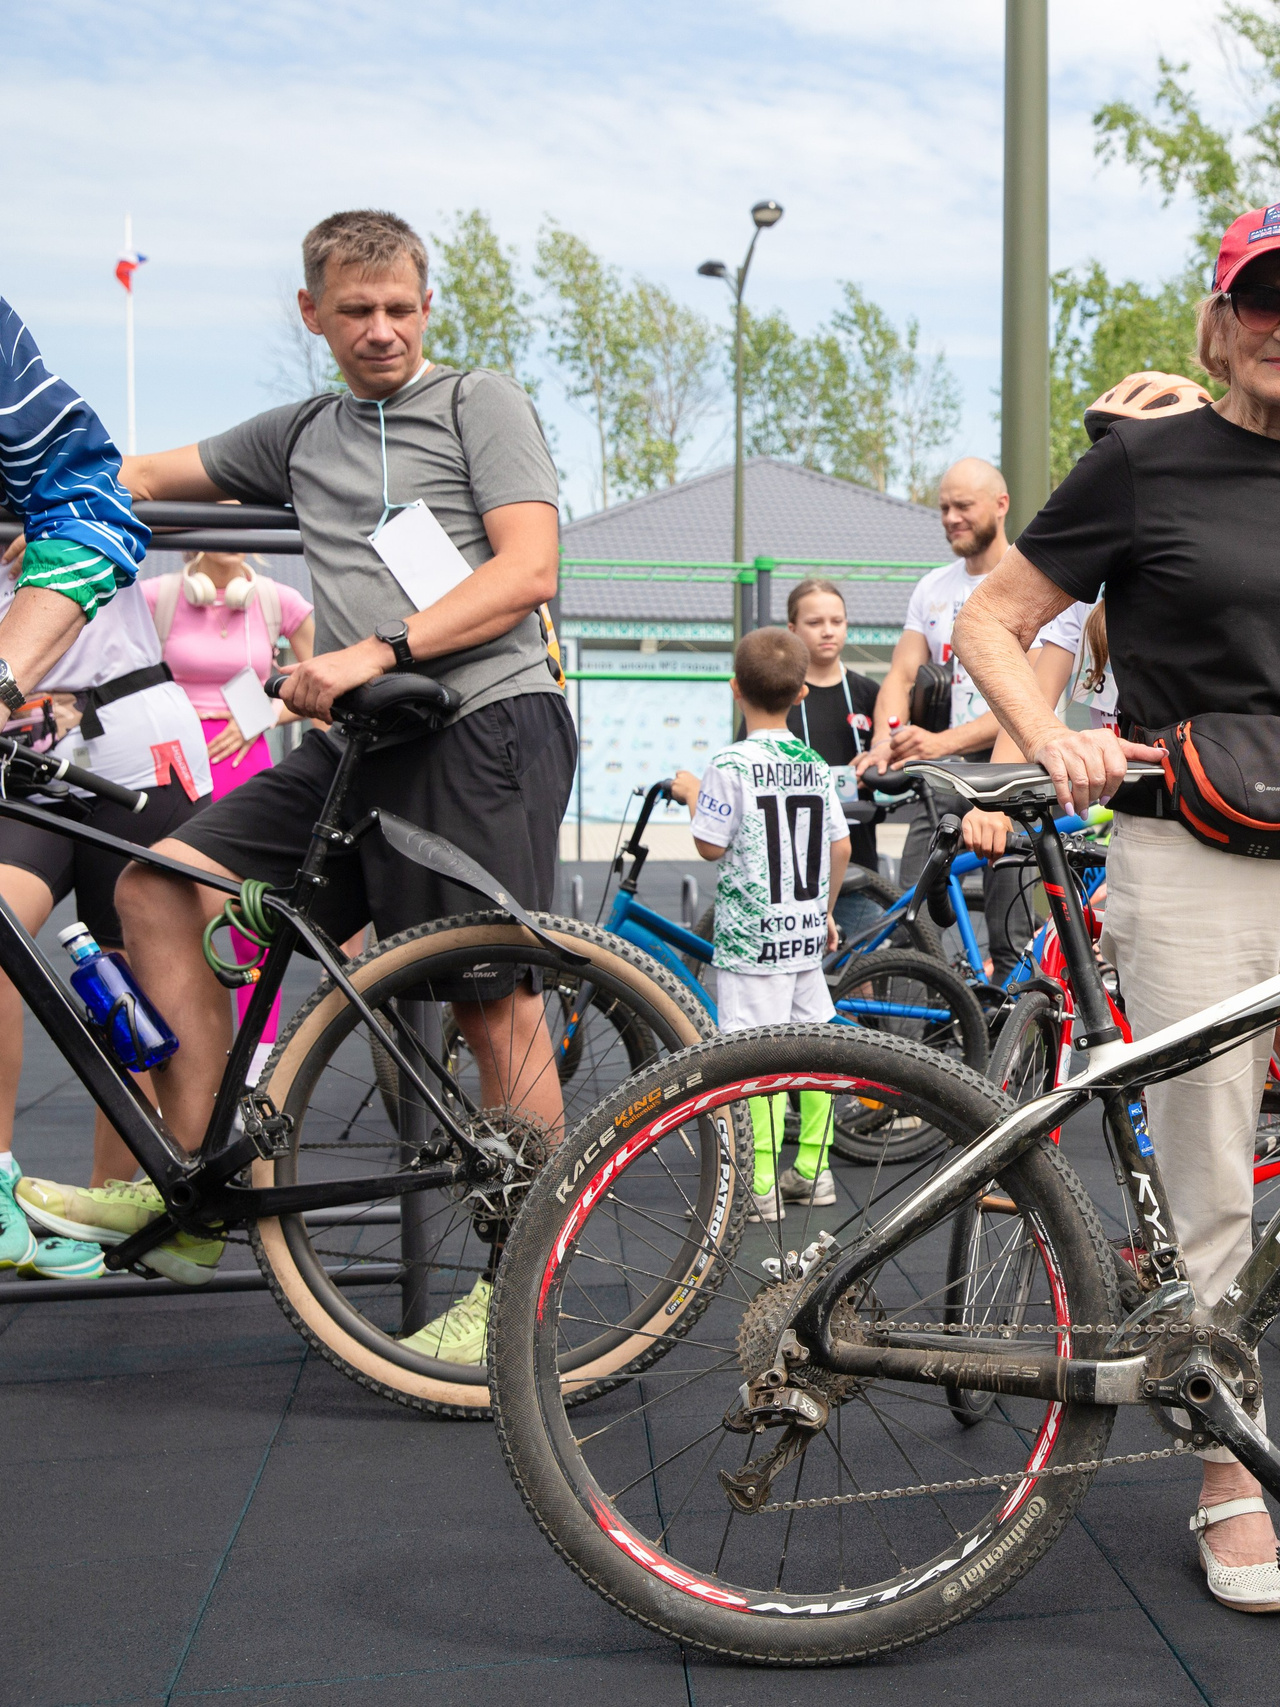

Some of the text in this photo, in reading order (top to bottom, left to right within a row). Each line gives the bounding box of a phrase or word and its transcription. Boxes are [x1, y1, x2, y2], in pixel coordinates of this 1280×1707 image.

[756, 795, 824, 904] 10
[760, 915, 796, 933] КТО
[555, 1126, 617, 1205] RACE
[614, 1086, 664, 1128] KING
[663, 1071, 704, 1100] 2.2
[622, 1098, 663, 1129] Continental
[556, 1073, 857, 1264] FULCRUM
[800, 1396, 818, 1417] X9
[607, 1529, 992, 1615] RED METAL
[960, 1495, 1047, 1598] Continental
